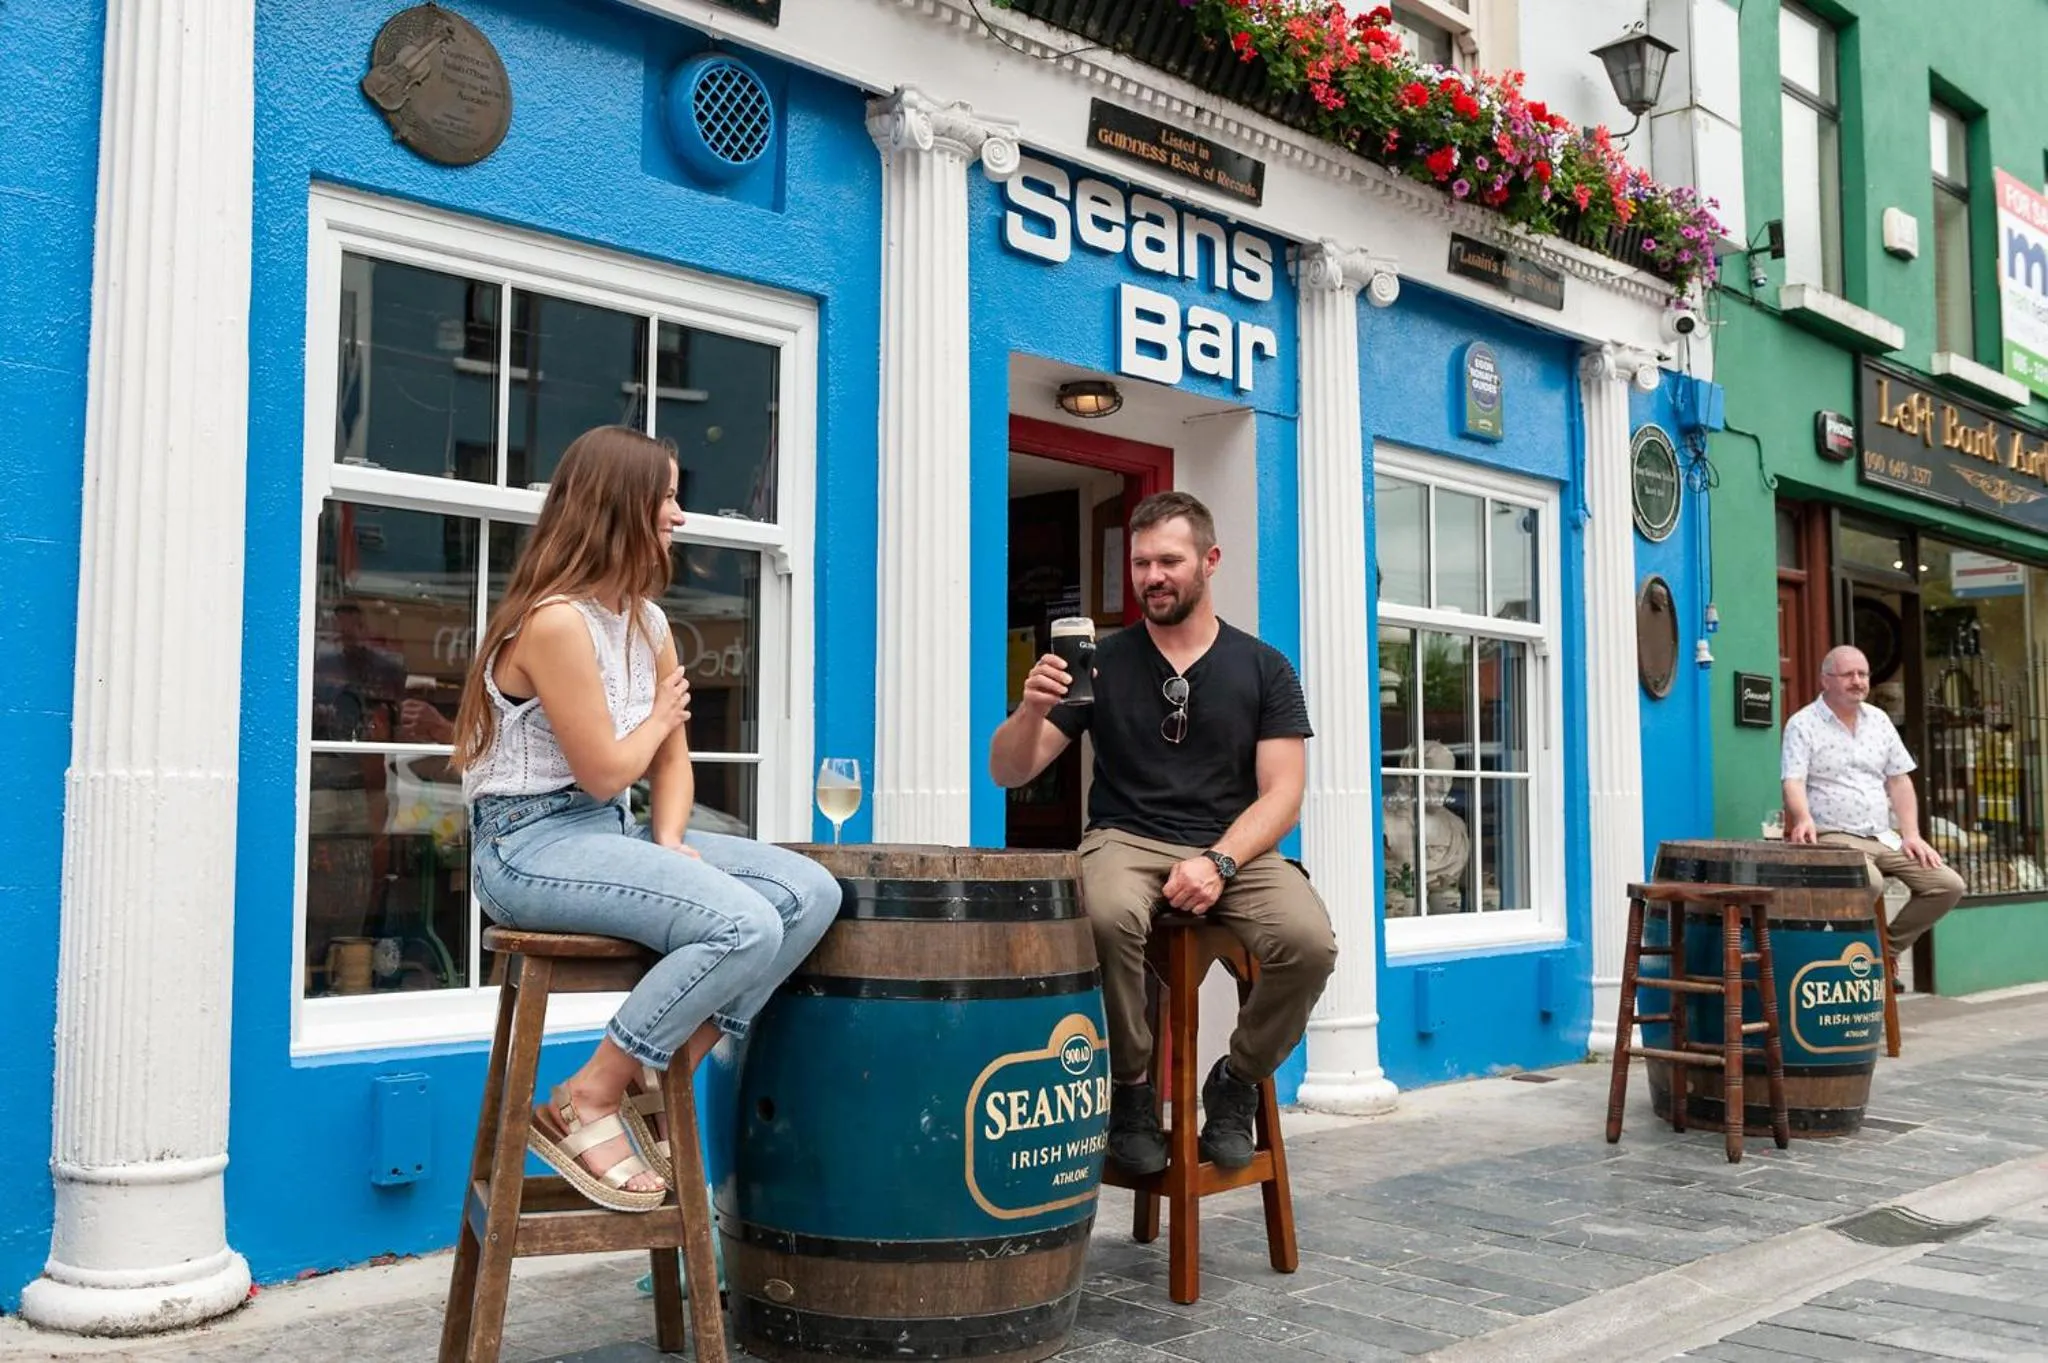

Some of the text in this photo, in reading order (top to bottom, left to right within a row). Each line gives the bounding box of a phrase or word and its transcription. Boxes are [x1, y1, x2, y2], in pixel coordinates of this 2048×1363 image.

[1161, 129, 1209, 160] Listed in
[1098, 128, 1257, 198] GUINNESS Book of Records
[2005, 184, 2030, 219] FOR
[1006, 155, 1273, 301] Seans
[1120, 282, 1277, 392] Bar
[1876, 378, 1934, 448] Left
[1941, 404, 2001, 463] Bank
[1801, 979, 1871, 1009] SEAN'S
[1819, 1014, 1850, 1026] IRISH
[984, 1078, 1092, 1140] SEAN'S
[1011, 1145, 1062, 1170] IRISH
[1052, 1166, 1090, 1186] ATHLONE
